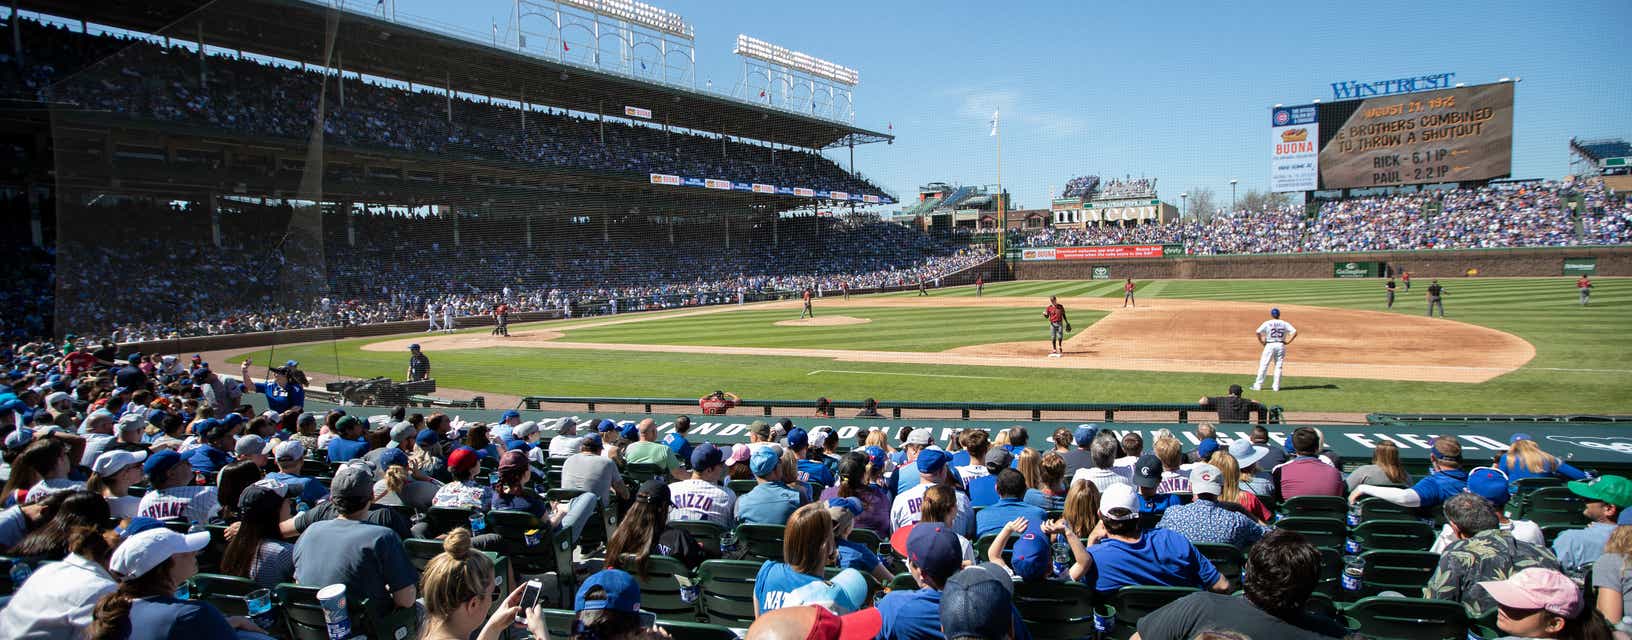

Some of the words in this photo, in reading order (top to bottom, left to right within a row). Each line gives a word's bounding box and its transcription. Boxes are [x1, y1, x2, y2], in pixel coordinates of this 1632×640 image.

[1331, 73, 1455, 99] WINTRUST
[1350, 119, 1416, 138] BROTHERS
[1420, 106, 1494, 127] COMBINED
[1338, 140, 1353, 152] TO
[1359, 134, 1402, 151] THROW
[1407, 131, 1417, 144] A
[1422, 122, 1482, 141] SHUTOUT
[1275, 141, 1313, 155] BUONA
[1374, 154, 1400, 168] RICK
[1373, 171, 1402, 184] PAUL
[1270, 328, 1285, 338] 25
[674, 493, 714, 511] RIZZO
